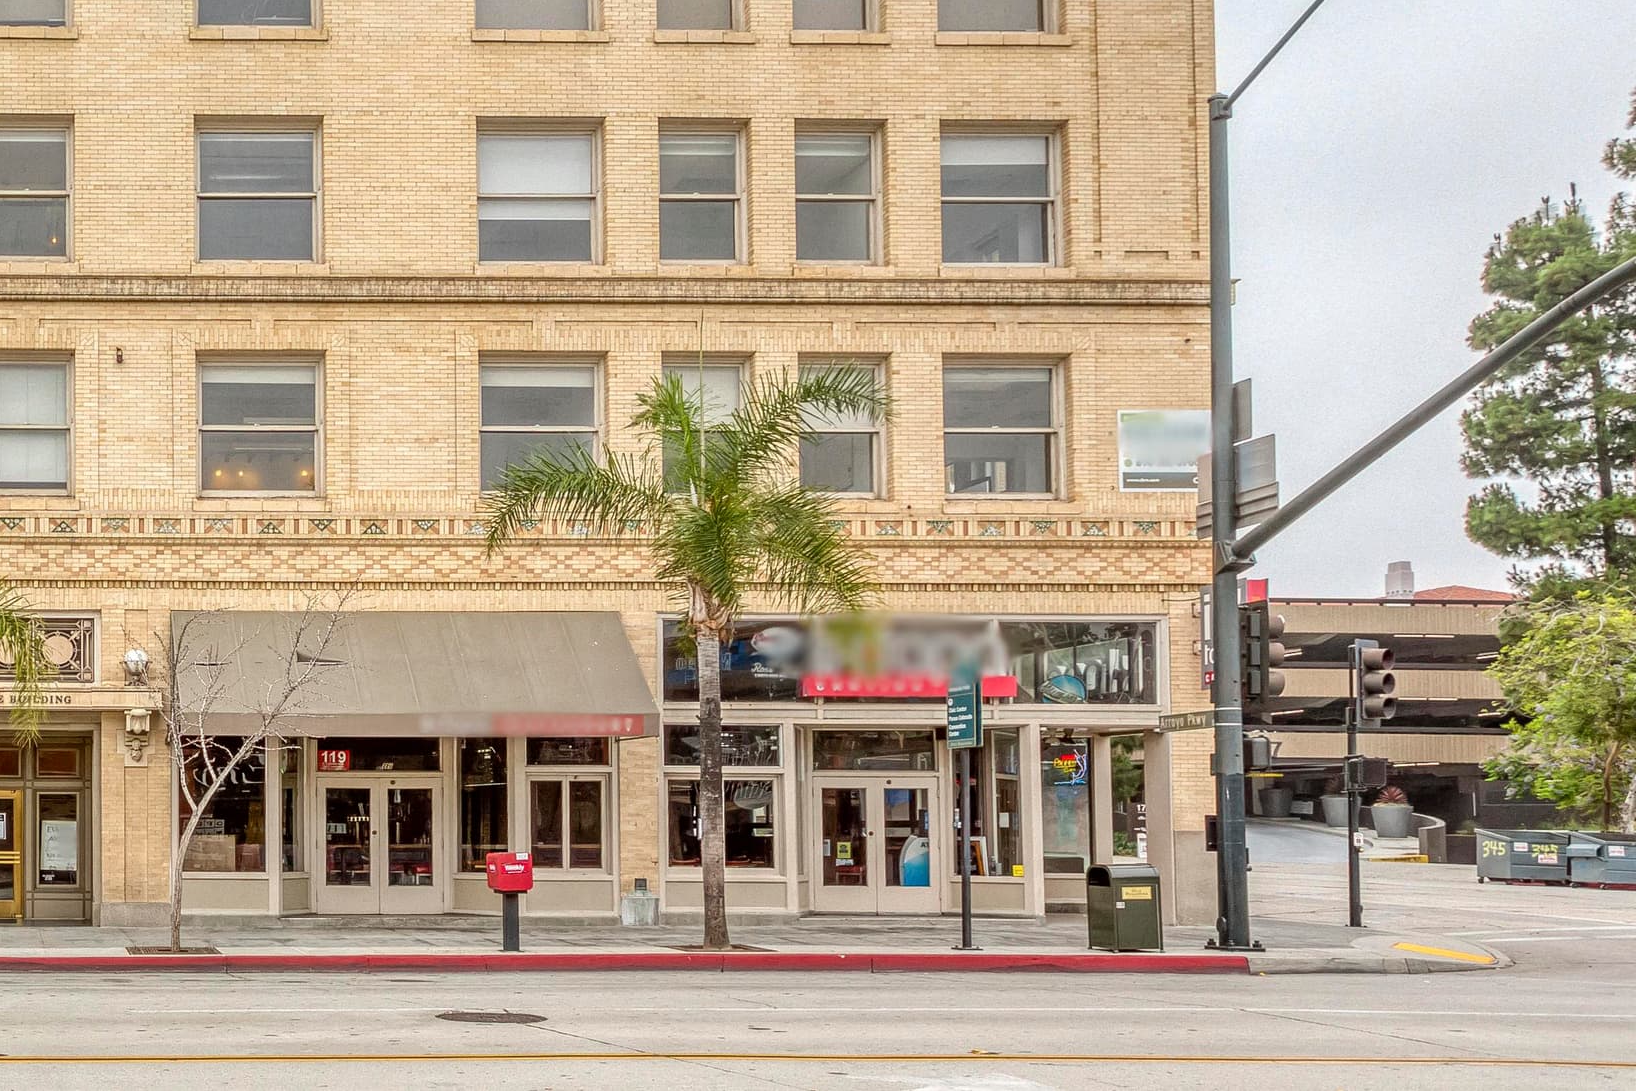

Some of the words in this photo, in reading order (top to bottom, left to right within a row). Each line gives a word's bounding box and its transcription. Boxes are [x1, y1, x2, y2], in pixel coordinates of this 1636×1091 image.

[1160, 717, 1184, 730] Arroyo
[1187, 713, 1206, 727] Pkwy
[321, 751, 347, 763] 119
[1482, 840, 1506, 858] 345
